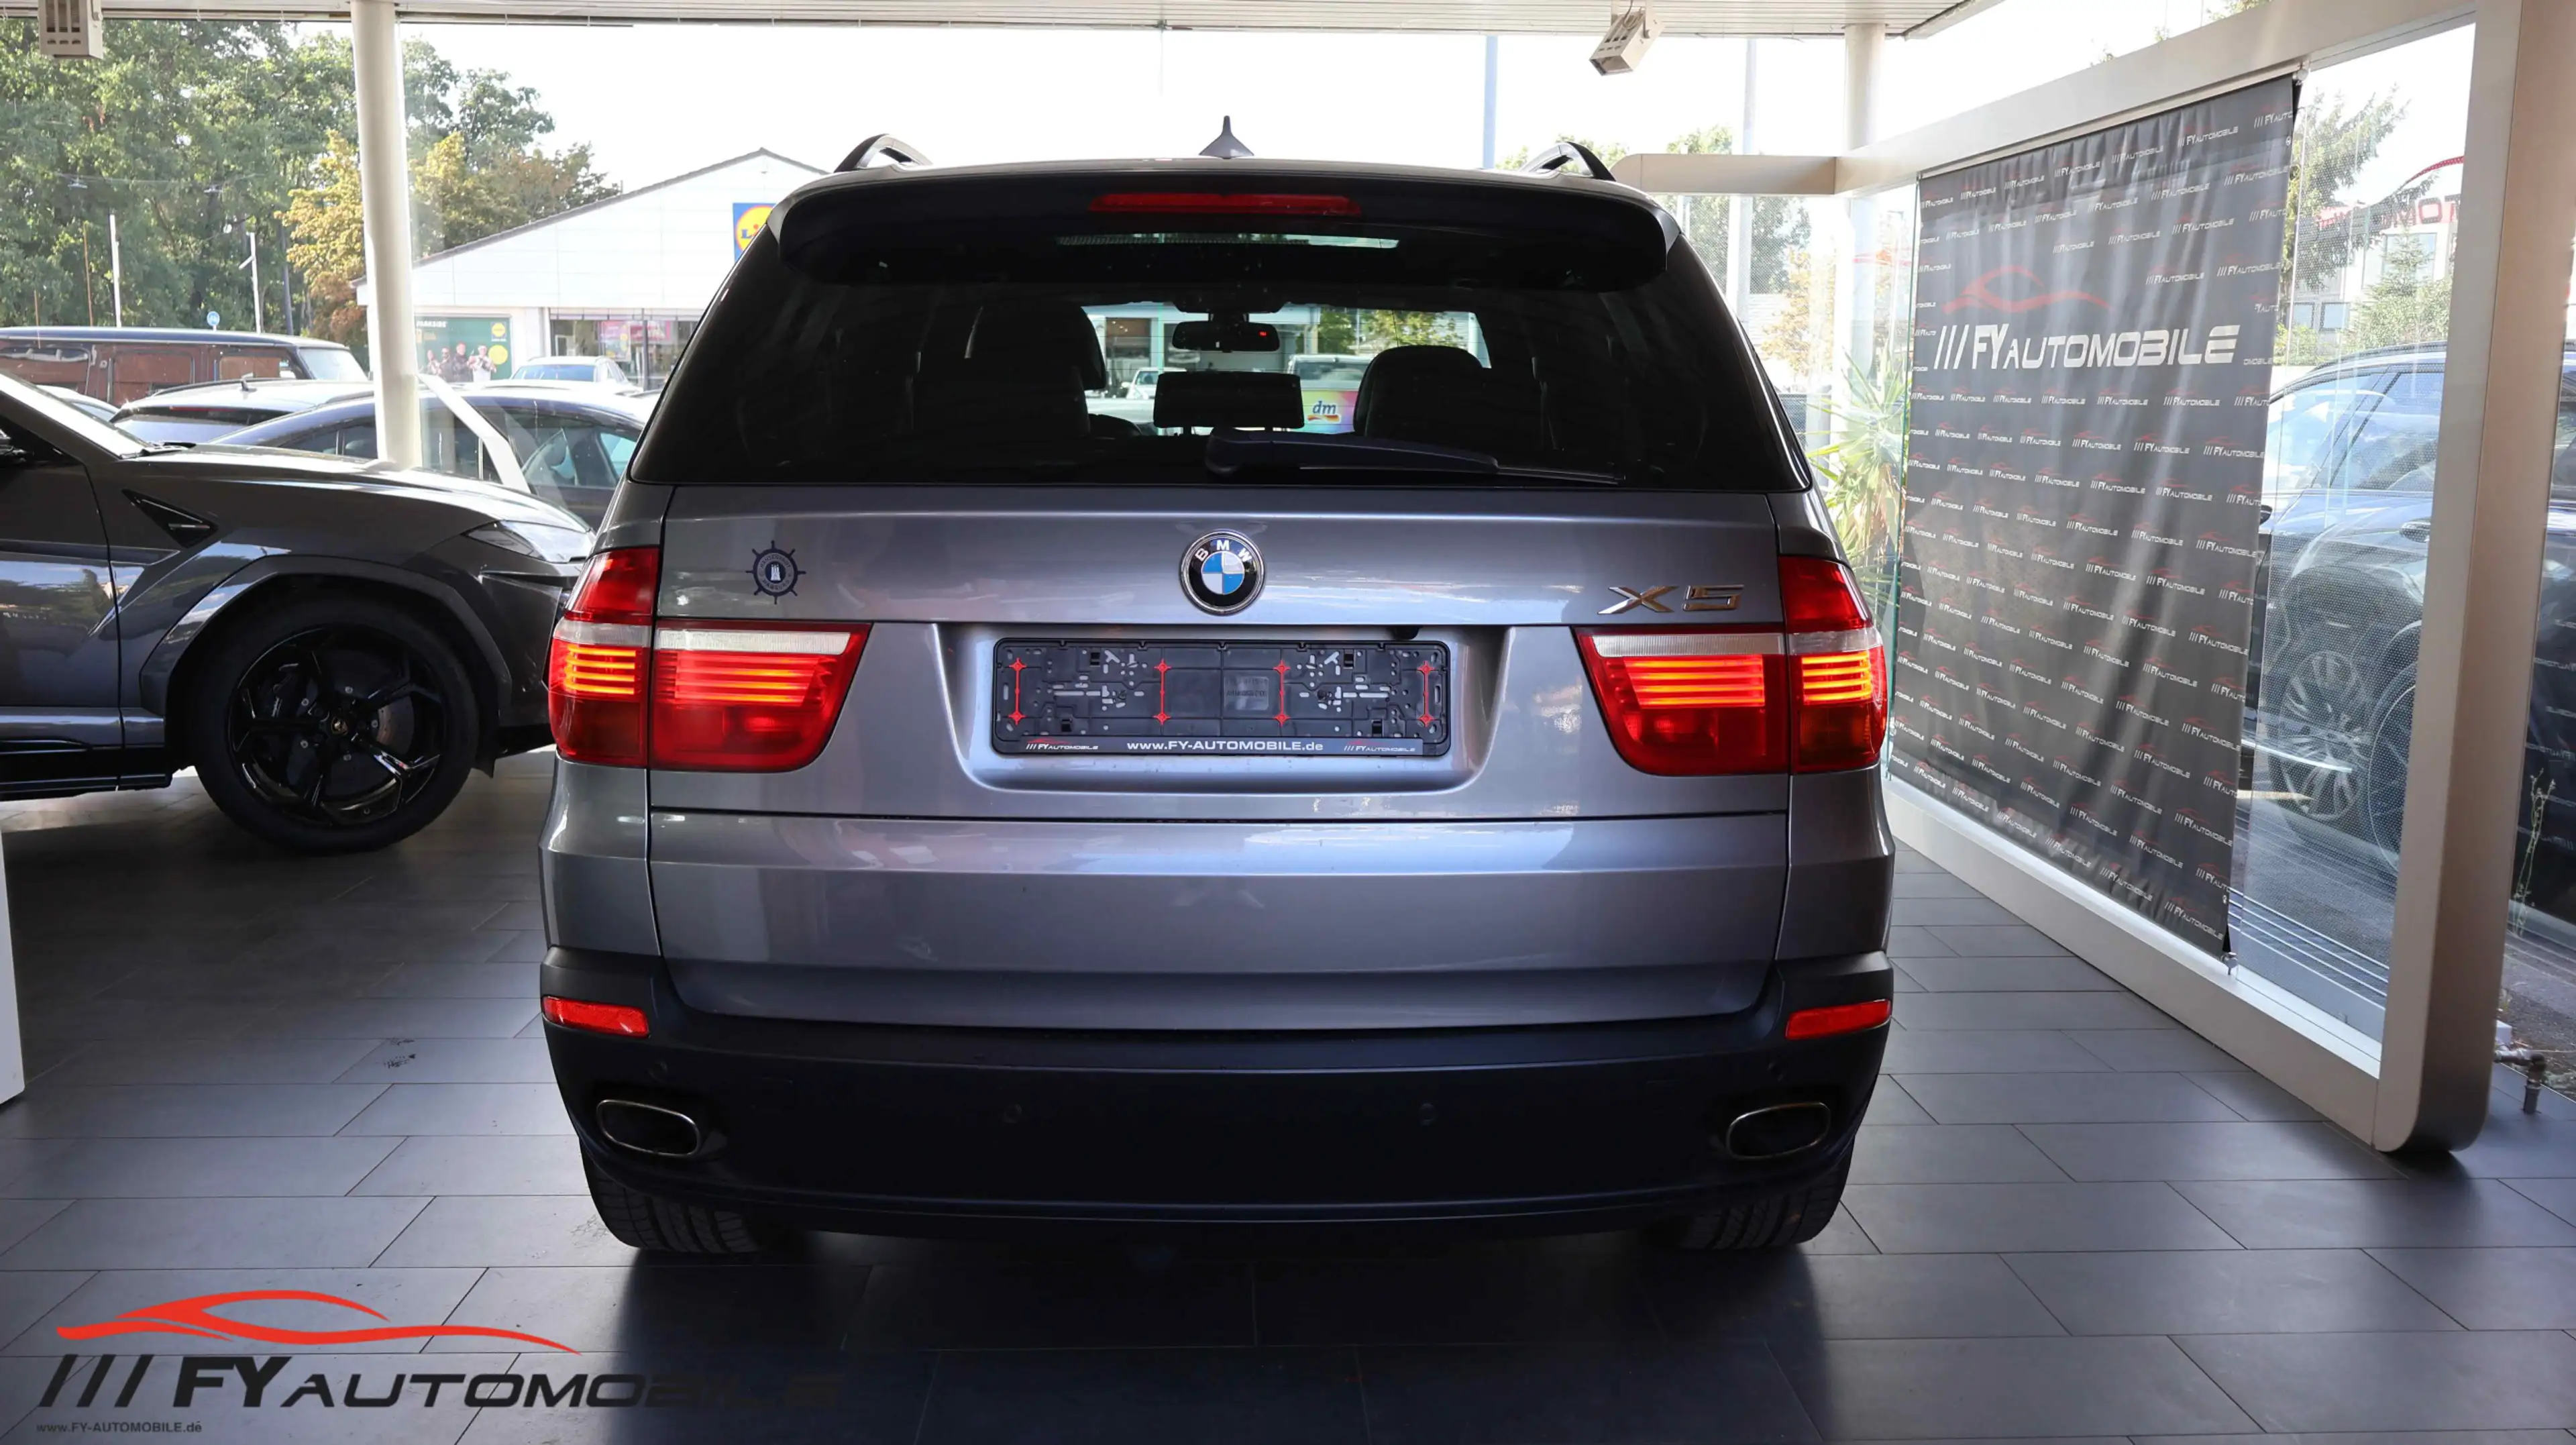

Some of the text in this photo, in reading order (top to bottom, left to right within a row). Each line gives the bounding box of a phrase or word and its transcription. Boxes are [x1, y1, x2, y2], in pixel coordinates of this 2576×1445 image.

[1313, 400, 1336, 415] dm
[1195, 539, 1252, 561] BMW
[1597, 584, 1745, 614] X5
[1127, 741, 1323, 751] www.FY-AUTOMOBILE.de
